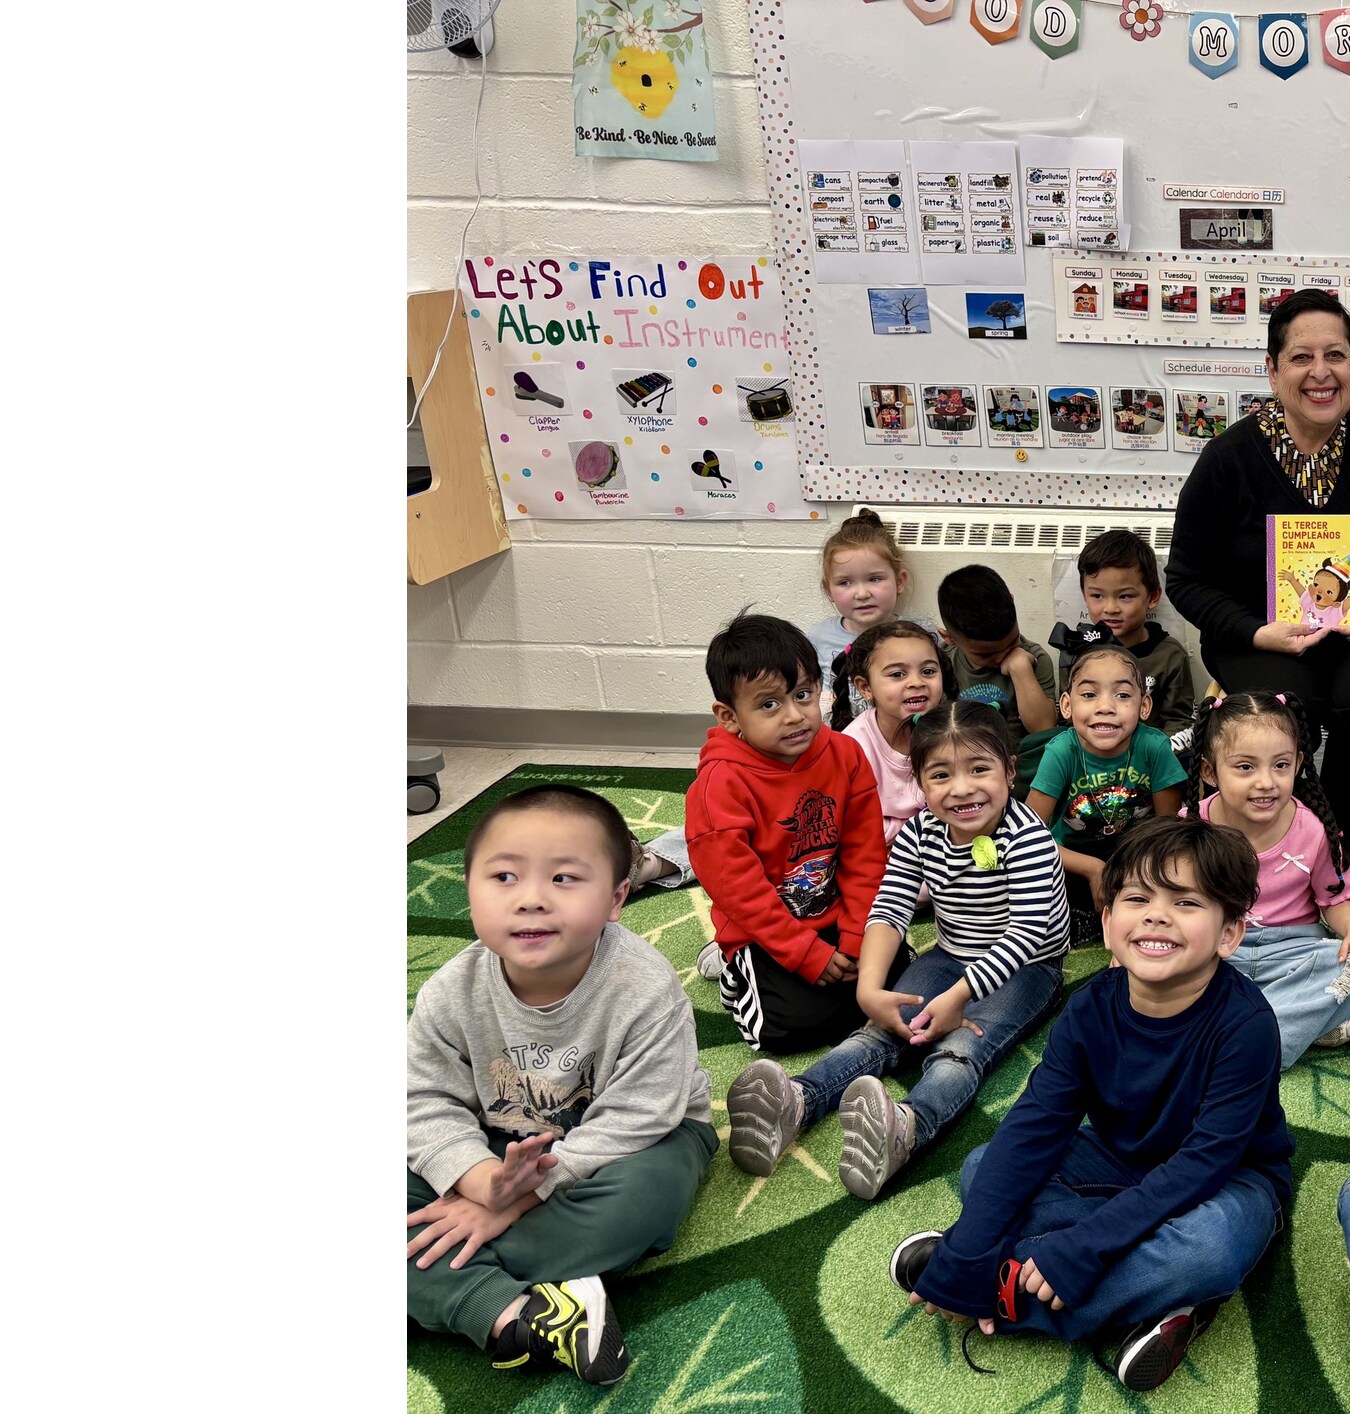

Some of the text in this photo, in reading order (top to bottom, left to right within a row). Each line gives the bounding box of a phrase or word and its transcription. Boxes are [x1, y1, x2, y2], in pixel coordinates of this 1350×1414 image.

[576, 126, 717, 147] Be Kind Be Nice Be Sweet
[858, 177, 888, 185] compacted
[1080, 174, 1102, 182] pretend
[1166, 188, 1260, 200] Calendar Calendario
[818, 195, 844, 203] compost
[1079, 195, 1101, 203] recycle
[1080, 214, 1102, 222] reduce
[937, 220, 959, 228] nothing
[974, 220, 1000, 228] organic
[1207, 222, 1246, 240] April
[881, 239, 898, 247] glass
[929, 239, 949, 247] paper
[976, 240, 1000, 248] plastic
[1116, 271, 1142, 279] Monday
[1164, 272, 1191, 280] Tuesday
[1209, 273, 1245, 281] Wednesday
[1261, 275, 1291, 283] Thursday
[588, 261, 667, 299] Find
[698, 262, 764, 300] Out
[1311, 277, 1332, 285] Friday
[498, 304, 601, 346] About
[1168, 363, 1250, 374] Schedule Horario
[754, 422, 781, 431] Drums
[708, 491, 736, 499] Maracas
[1282, 521, 1328, 530] EL TERCER
[1282, 530, 1341, 540] CUMPLEAÑOS
[1282, 541, 1316, 549] DE ANA
